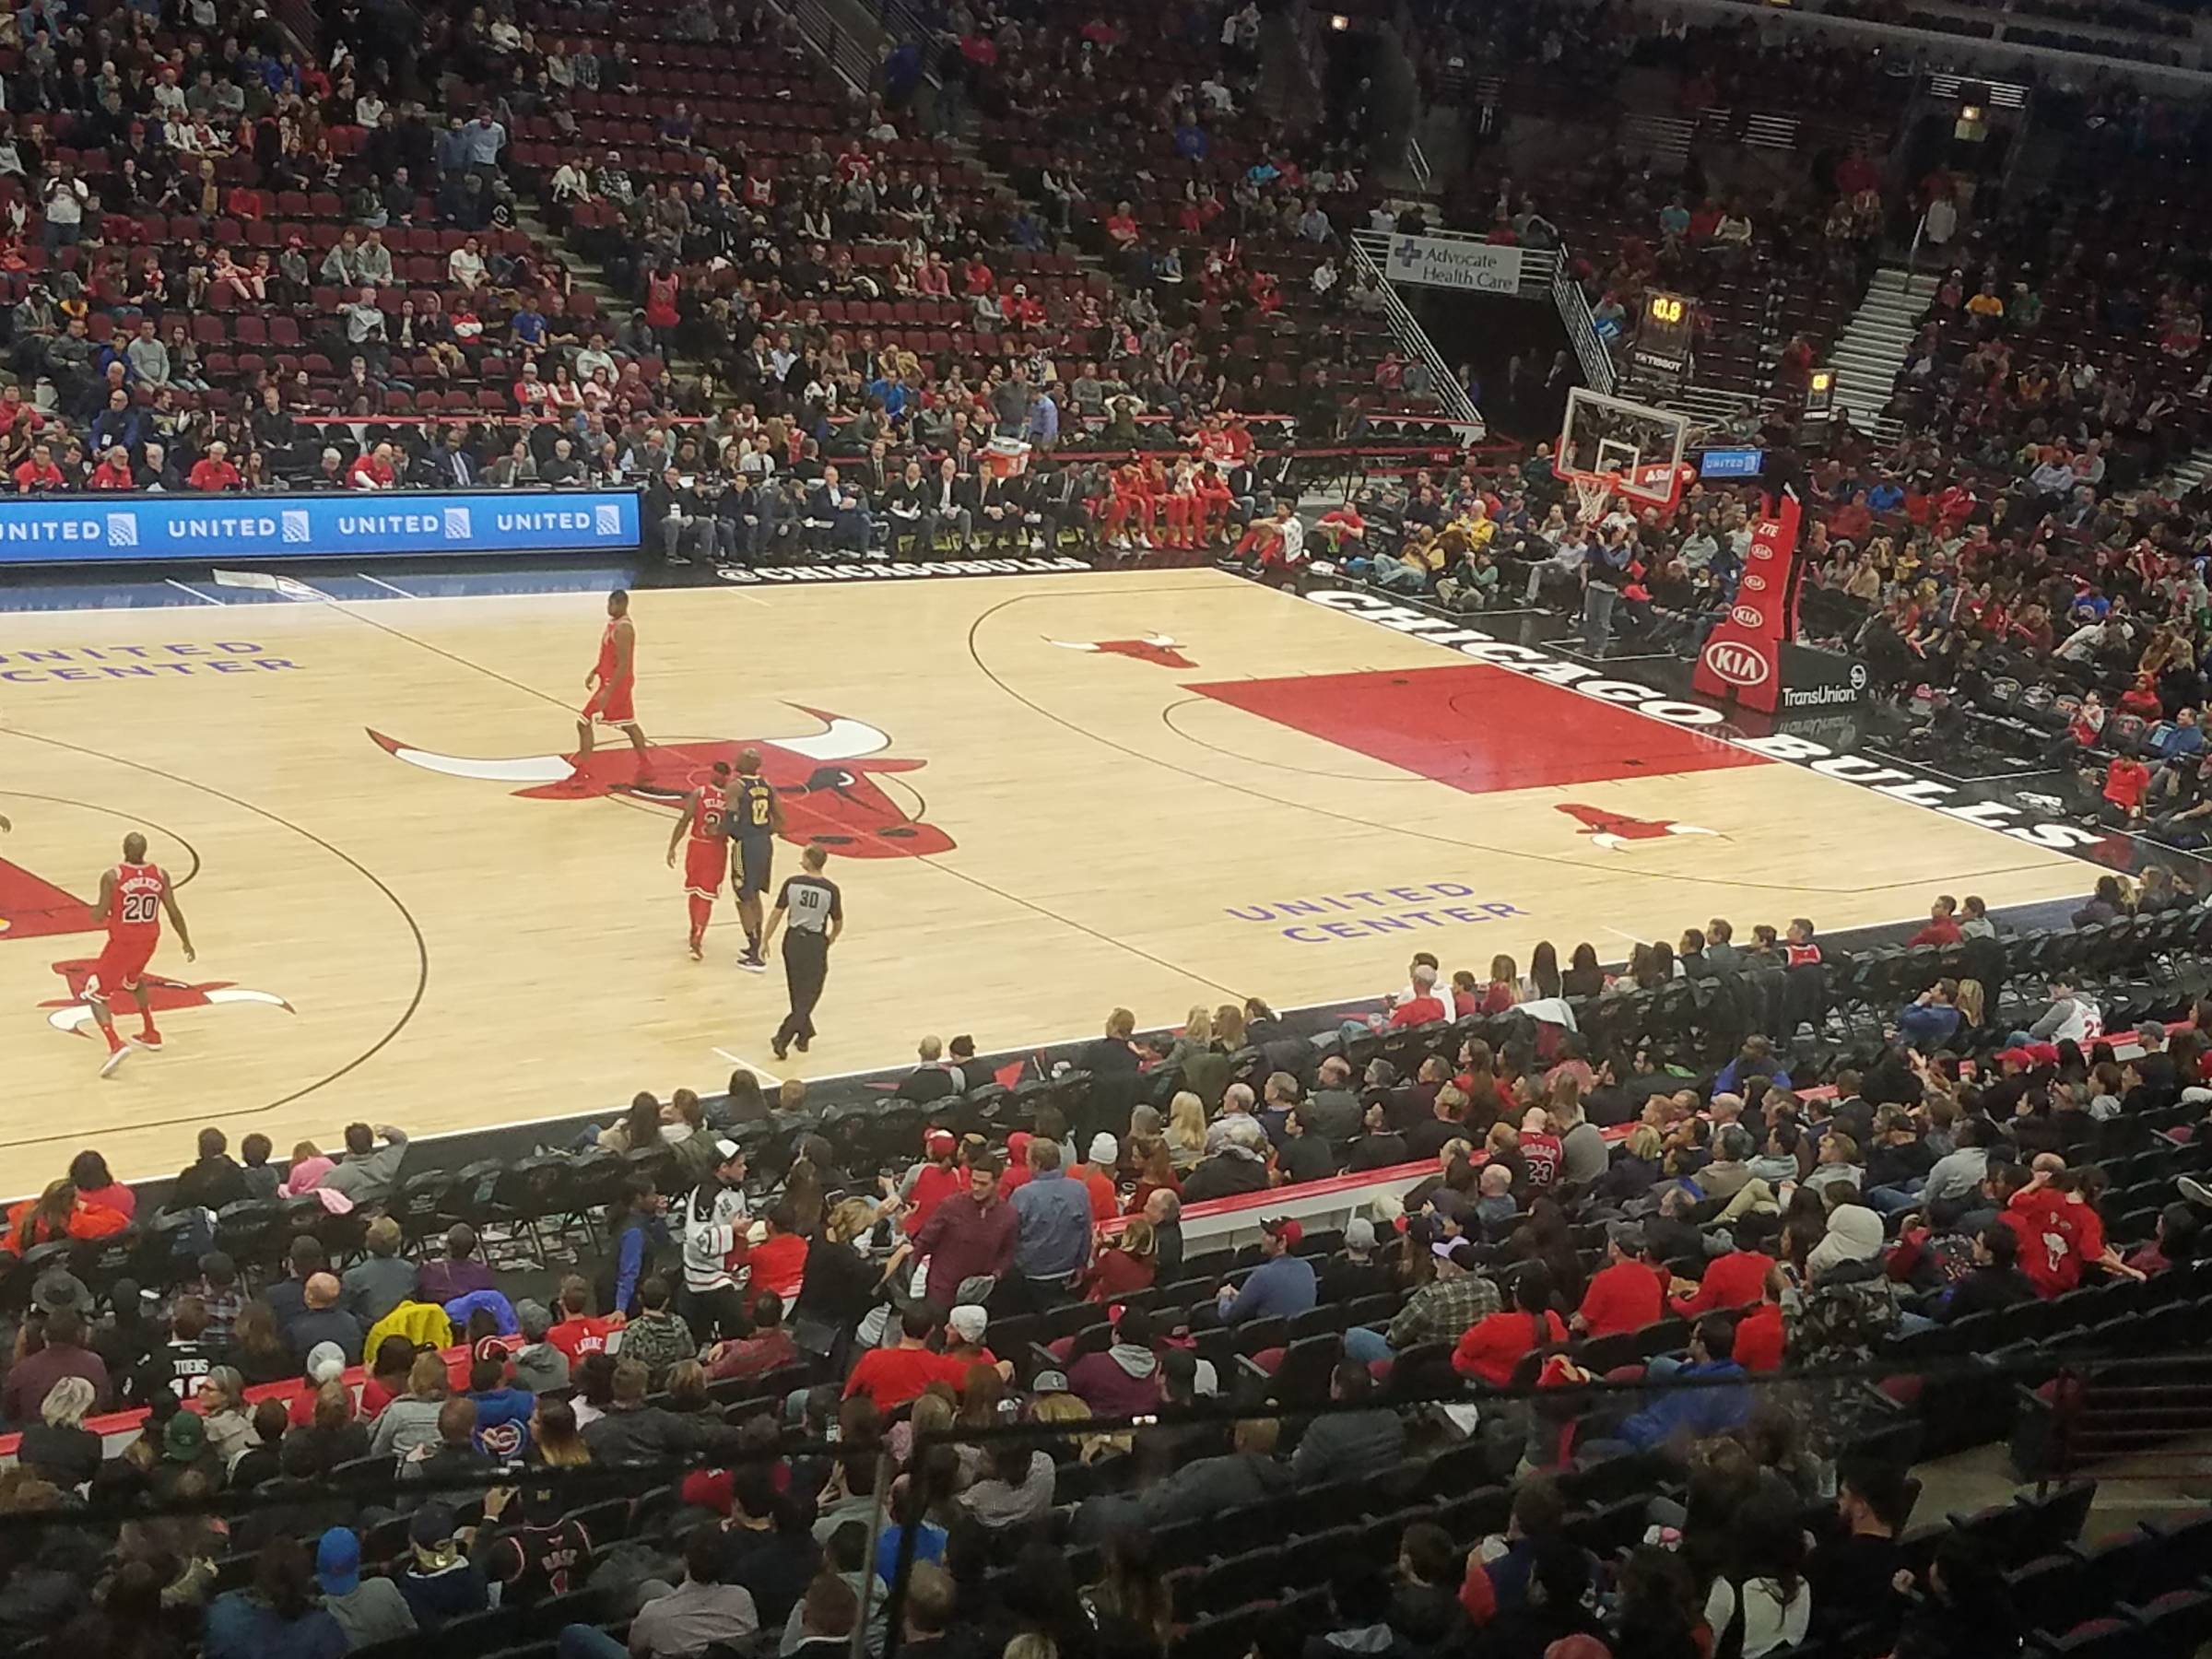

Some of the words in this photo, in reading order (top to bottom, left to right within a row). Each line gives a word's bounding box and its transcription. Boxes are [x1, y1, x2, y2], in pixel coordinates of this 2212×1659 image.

[1425, 247, 1497, 268] Advocate
[1423, 266, 1473, 286] Health
[1477, 275, 1512, 290] Care
[1646, 355, 1682, 372] TISSOT
[0, 521, 100, 541] NITED
[169, 519, 276, 537] UNITED
[338, 515, 439, 535] UNITED
[497, 512, 591, 531] UNITED
[1759, 522, 1780, 537] ZTE
[1306, 590, 1724, 724] CHICAGO
[1, 659, 305, 682] CENTER
[1783, 685, 1856, 707] TransUnion
[1729, 734, 2106, 848] BULLS
[124, 894, 158, 922] 20
[799, 890, 819, 909] 30
[1224, 883, 1475, 921] UNITED
[1282, 903, 1532, 942] CENTER
[1526, 1159, 1554, 1186] 23
